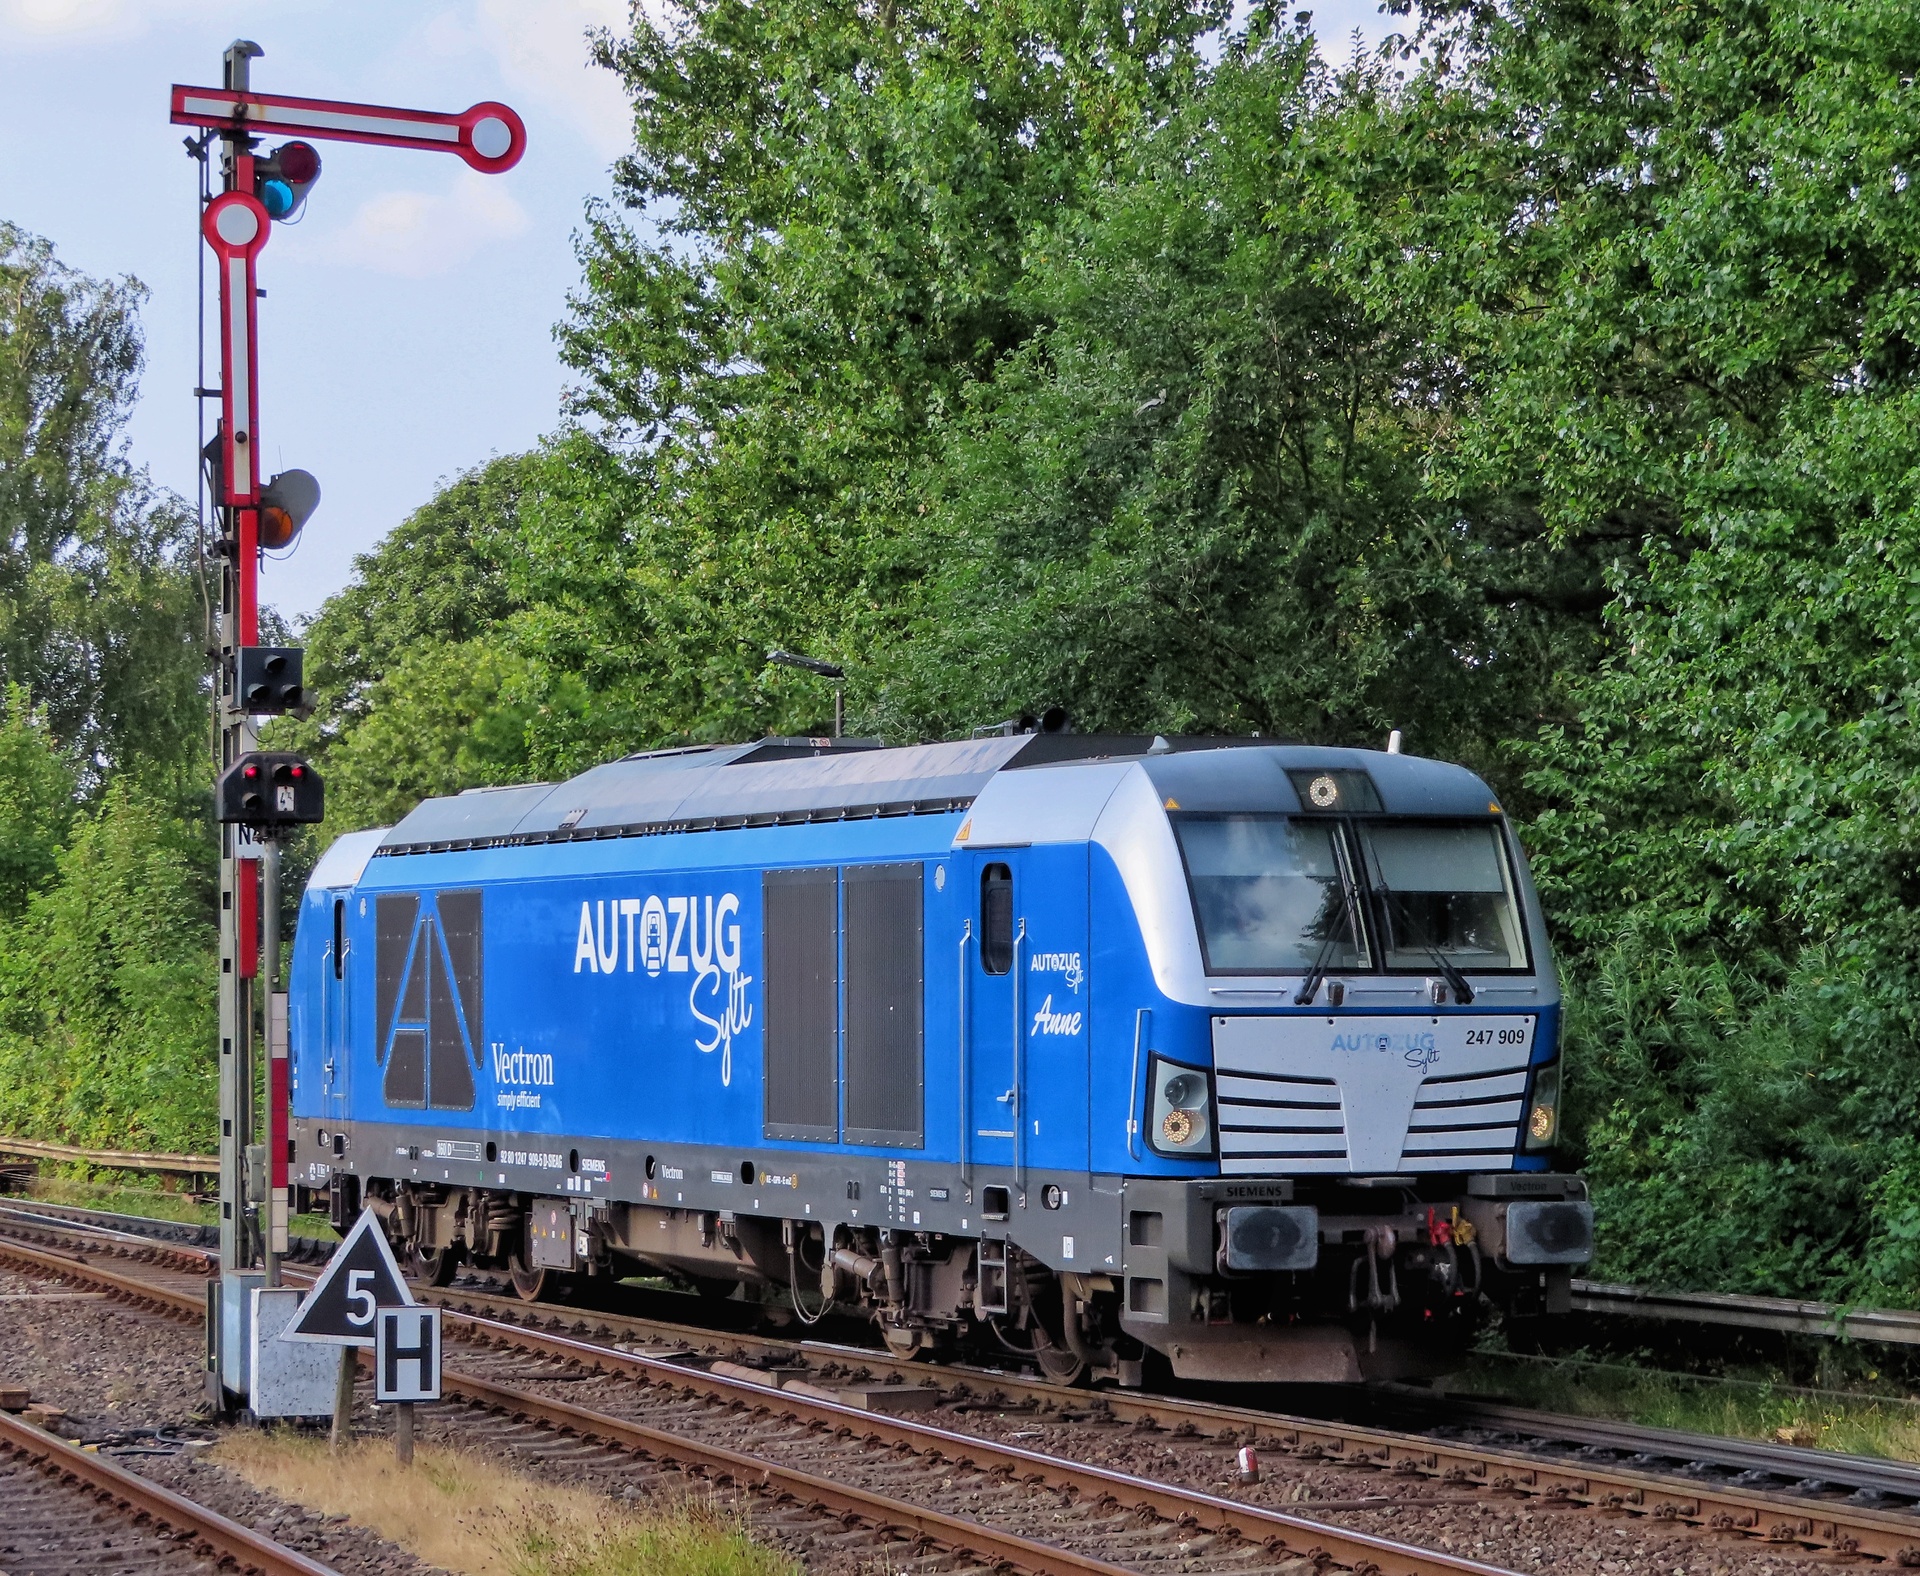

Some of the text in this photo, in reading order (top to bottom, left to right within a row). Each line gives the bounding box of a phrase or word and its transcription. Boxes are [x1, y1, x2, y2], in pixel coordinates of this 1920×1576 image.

[574, 893, 741, 978] AUTOZUG
[1031, 952, 1081, 972] AUTOZUG
[1065, 968, 1084, 995] Sylt
[690, 964, 753, 1087] Sylt
[1031, 993, 1082, 1037] Anne
[1331, 1032, 1435, 1053] AUTOZUG
[1466, 1029, 1525, 1045] 247 909
[491, 1042, 555, 1086] Vectron
[1404, 1048, 1440, 1075] Sylt
[497, 1090, 541, 1111] simply efficient
[500, 1150, 507, 1164] 92
[507, 1150, 514, 1164] 80
[514, 1151, 527, 1165] 1247
[528, 1152, 542, 1167] 909-5
[582, 1158, 606, 1172] SIEMENS
[661, 1164, 684, 1180] Vectron
[929, 1189, 947, 1199] SIEMENS
[1226, 1186, 1282, 1197] SIEMENS
[1510, 1181, 1547, 1192] Vectron
[346, 1269, 376, 1326] 5
[384, 1314, 433, 1392] H
